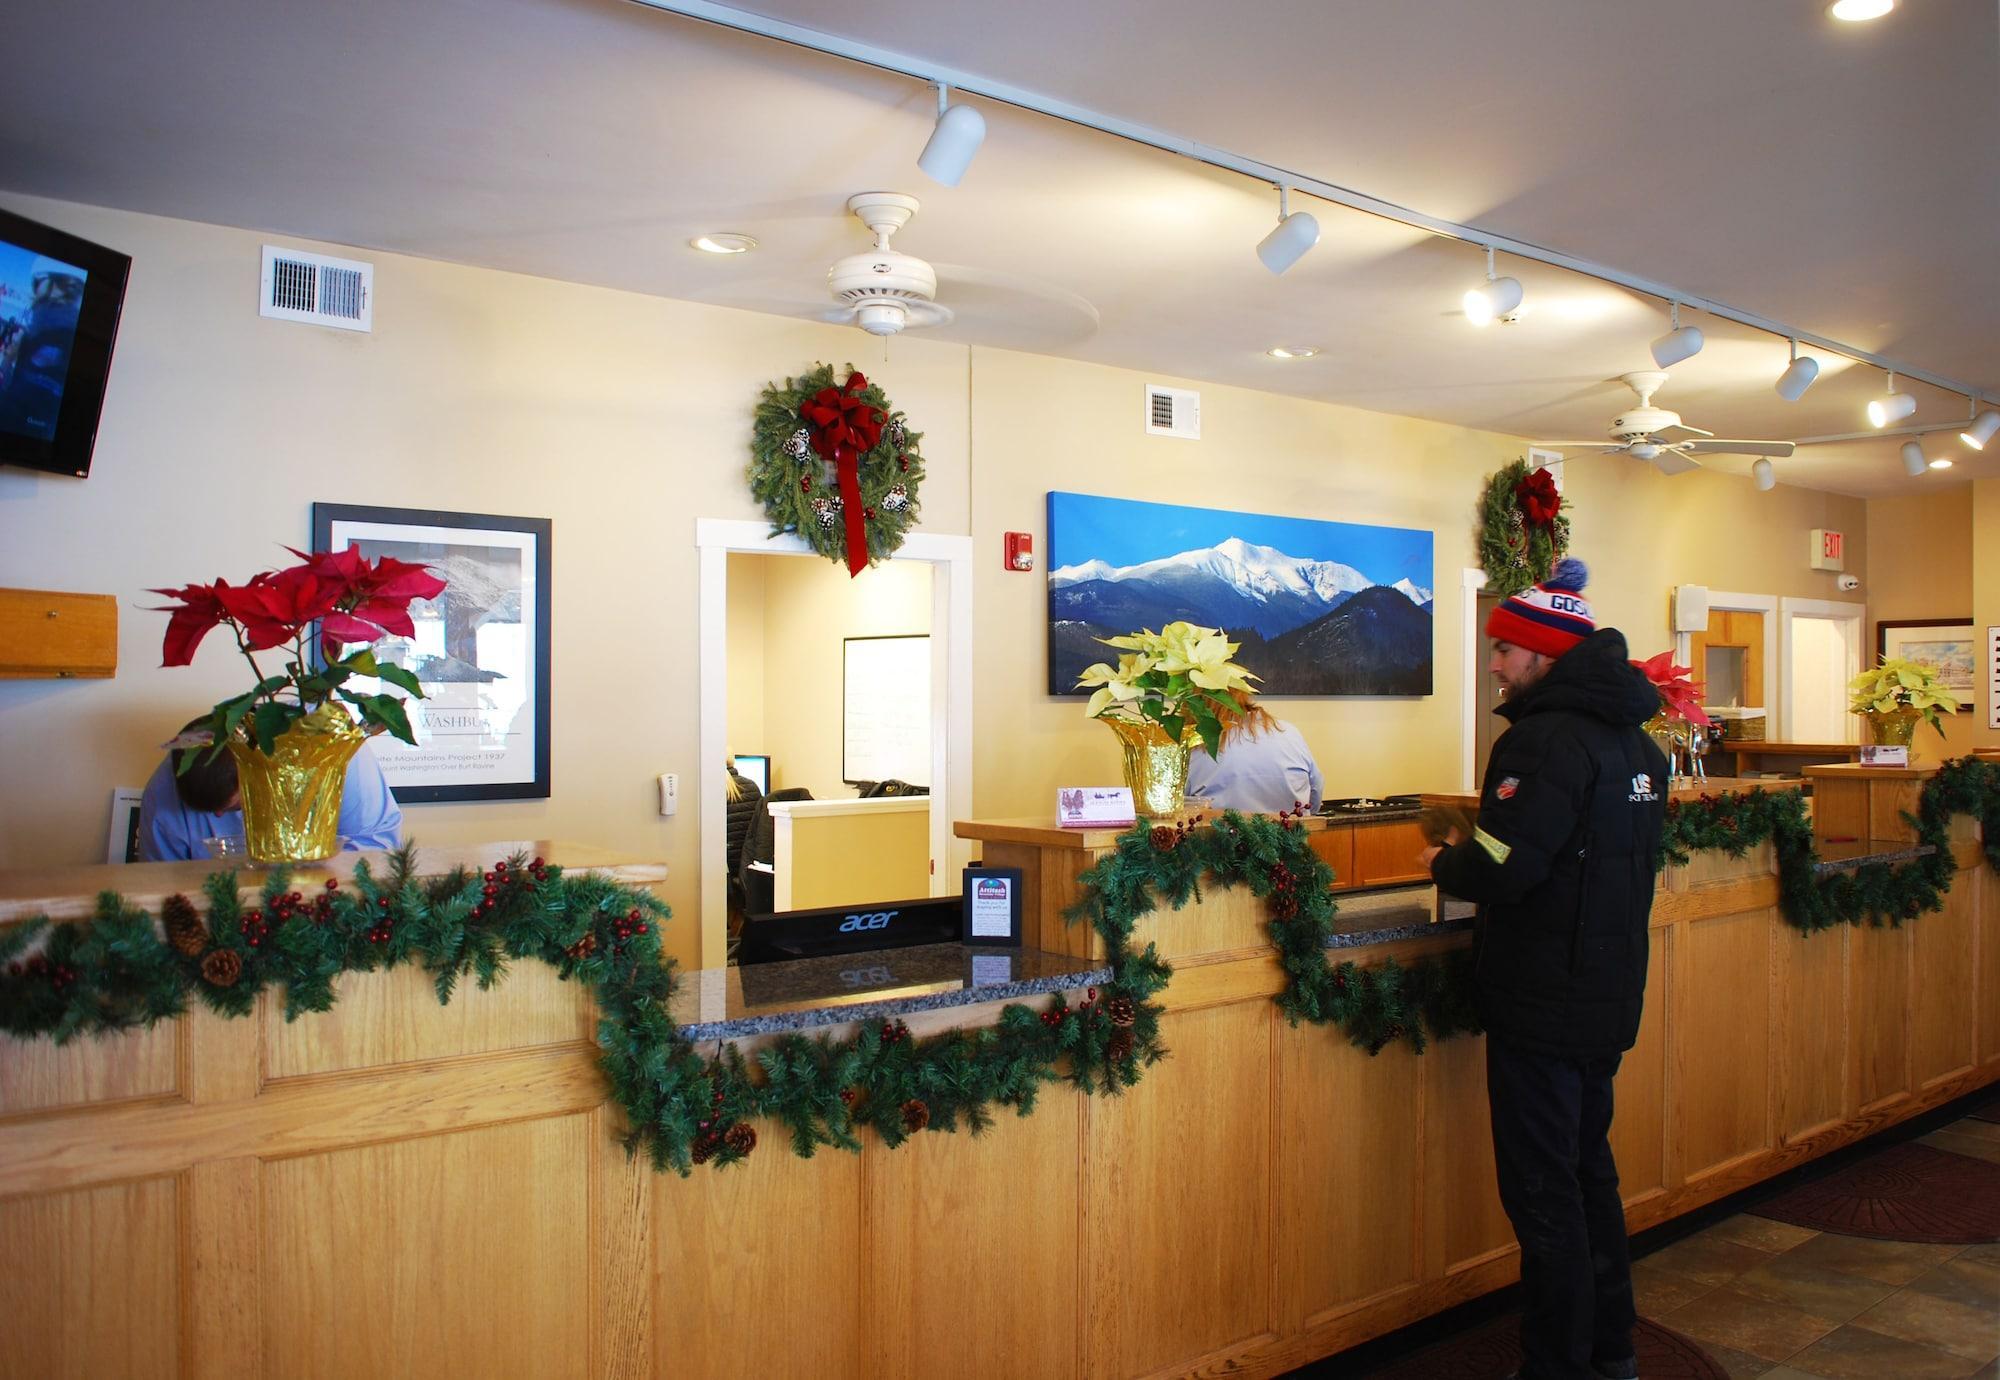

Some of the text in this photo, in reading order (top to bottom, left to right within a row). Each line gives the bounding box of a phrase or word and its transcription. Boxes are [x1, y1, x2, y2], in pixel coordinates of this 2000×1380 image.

[1824, 532, 1840, 559] EXIT
[1551, 595, 1589, 615] GOS
[395, 754, 445, 763] Mountains
[448, 753, 481, 763] Project
[485, 752, 505, 761] 1937
[400, 763, 439, 773] Washington
[839, 911, 898, 932] acer
